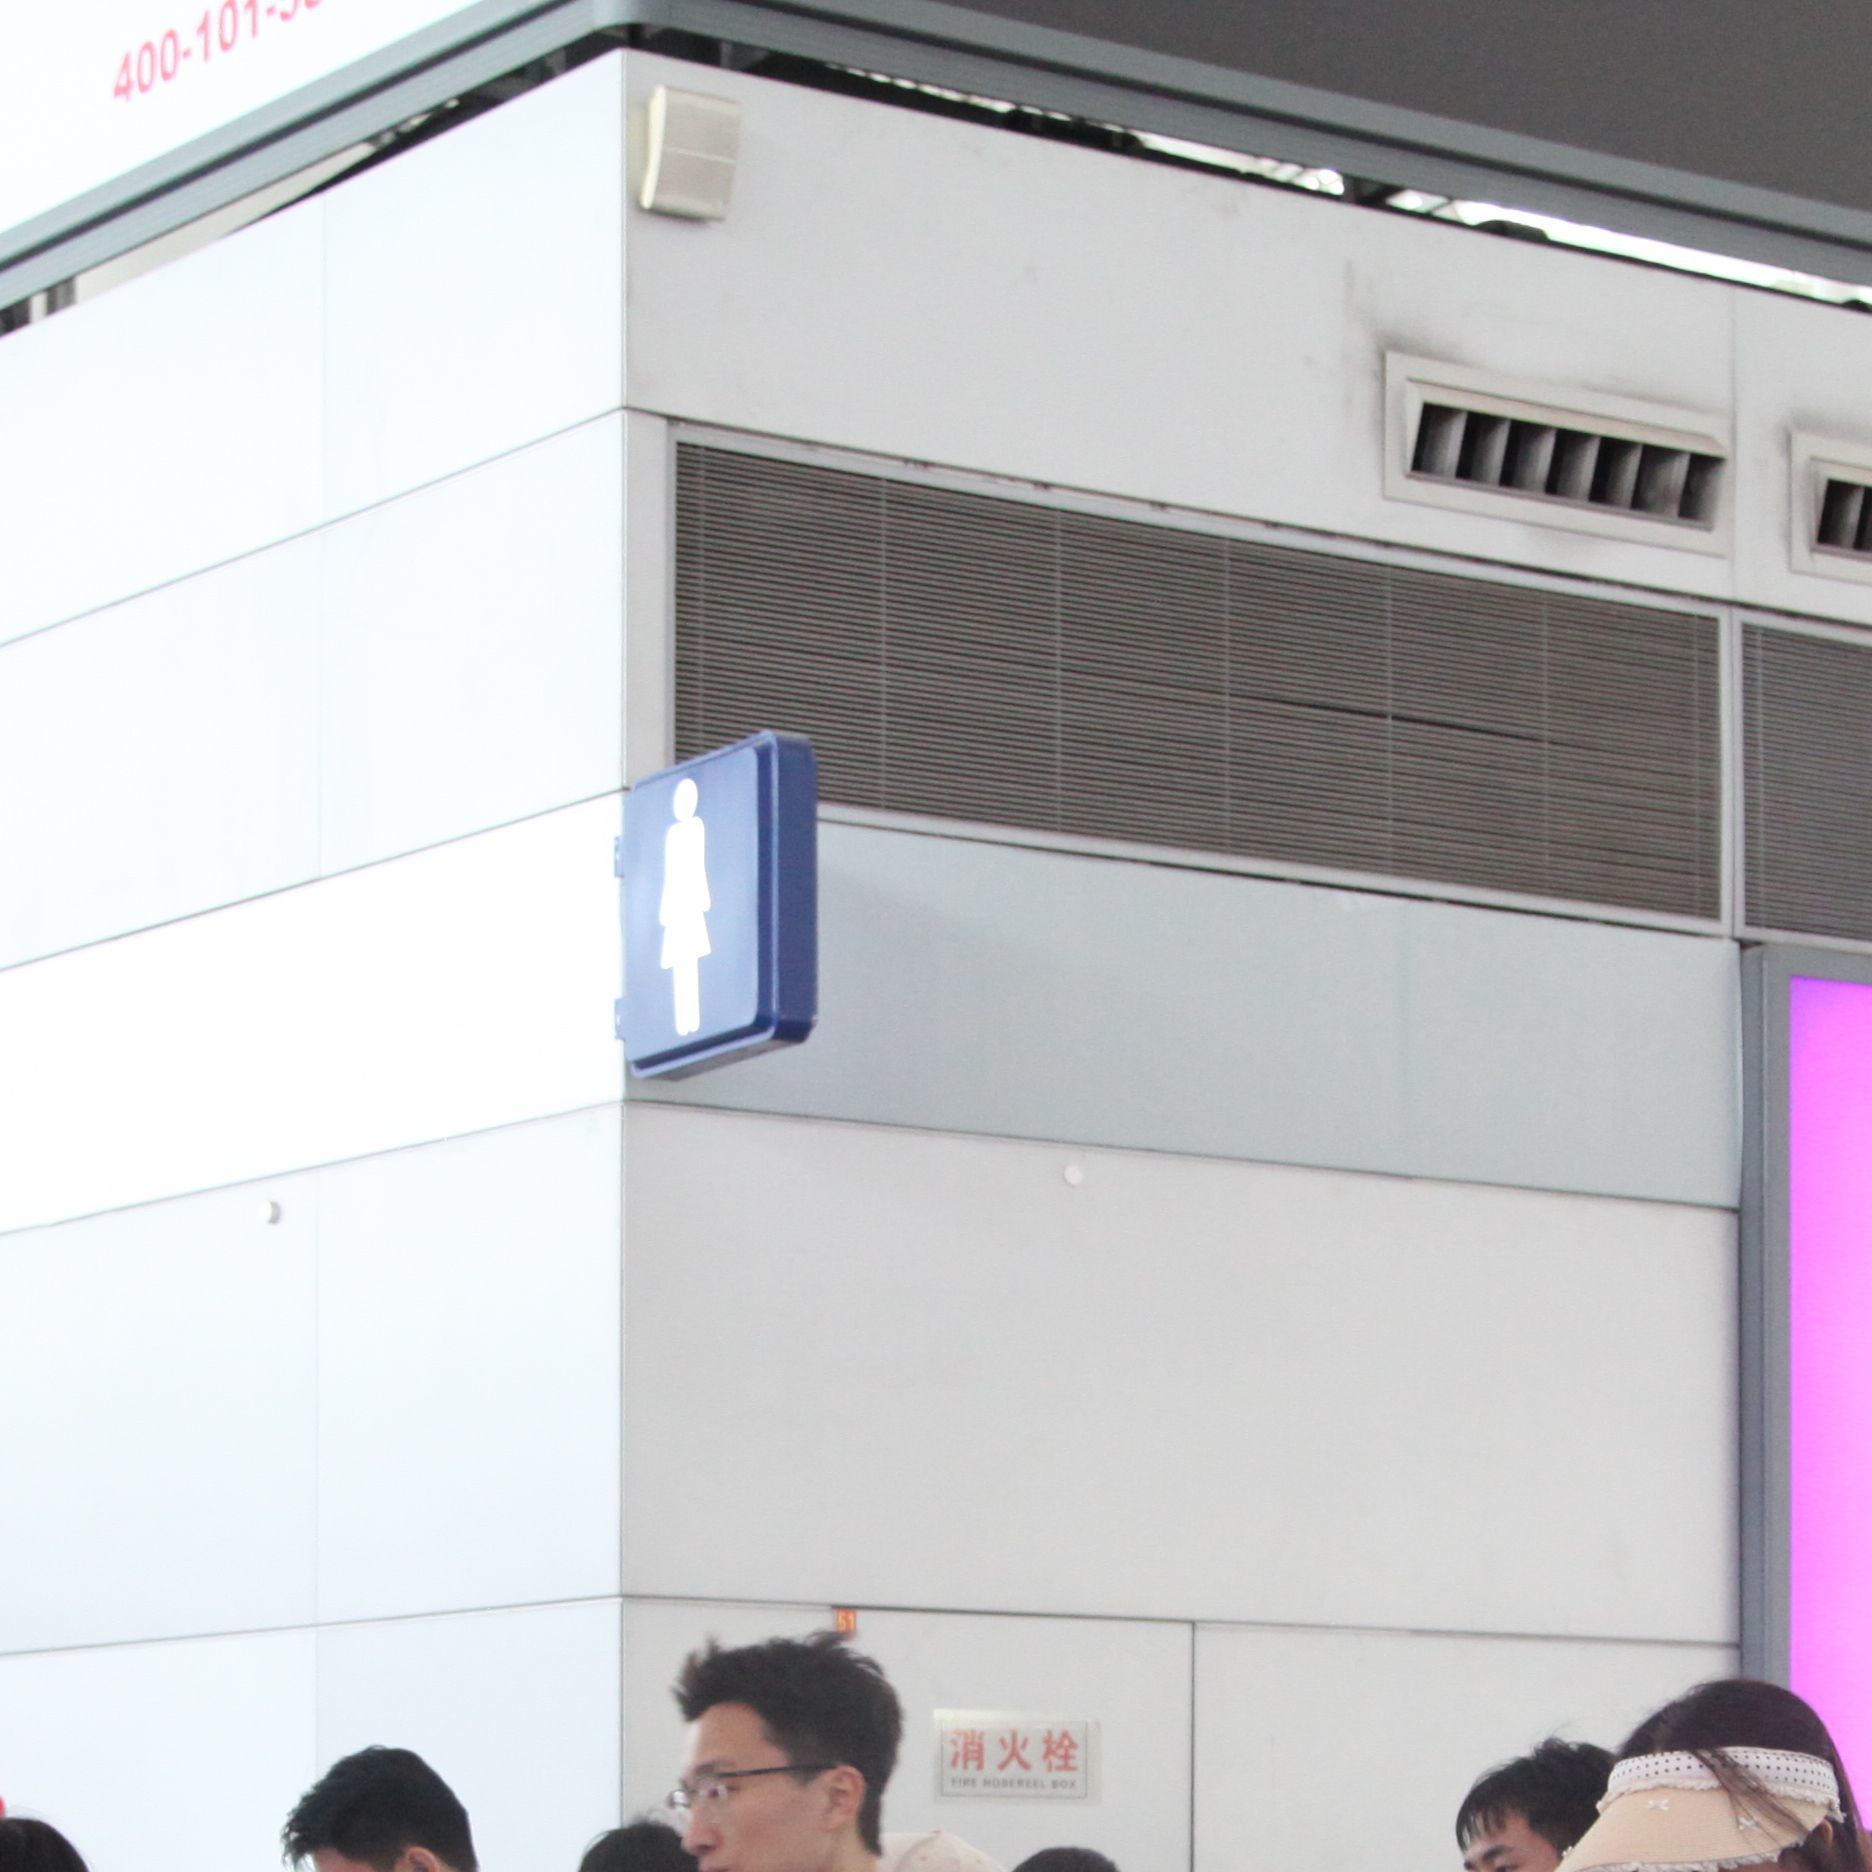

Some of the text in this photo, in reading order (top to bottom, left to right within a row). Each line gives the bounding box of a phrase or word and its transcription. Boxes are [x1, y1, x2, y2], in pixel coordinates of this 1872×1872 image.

[948, 1727, 1080, 1773] 消火栓
[1051, 1778, 1077, 1791] BOX
